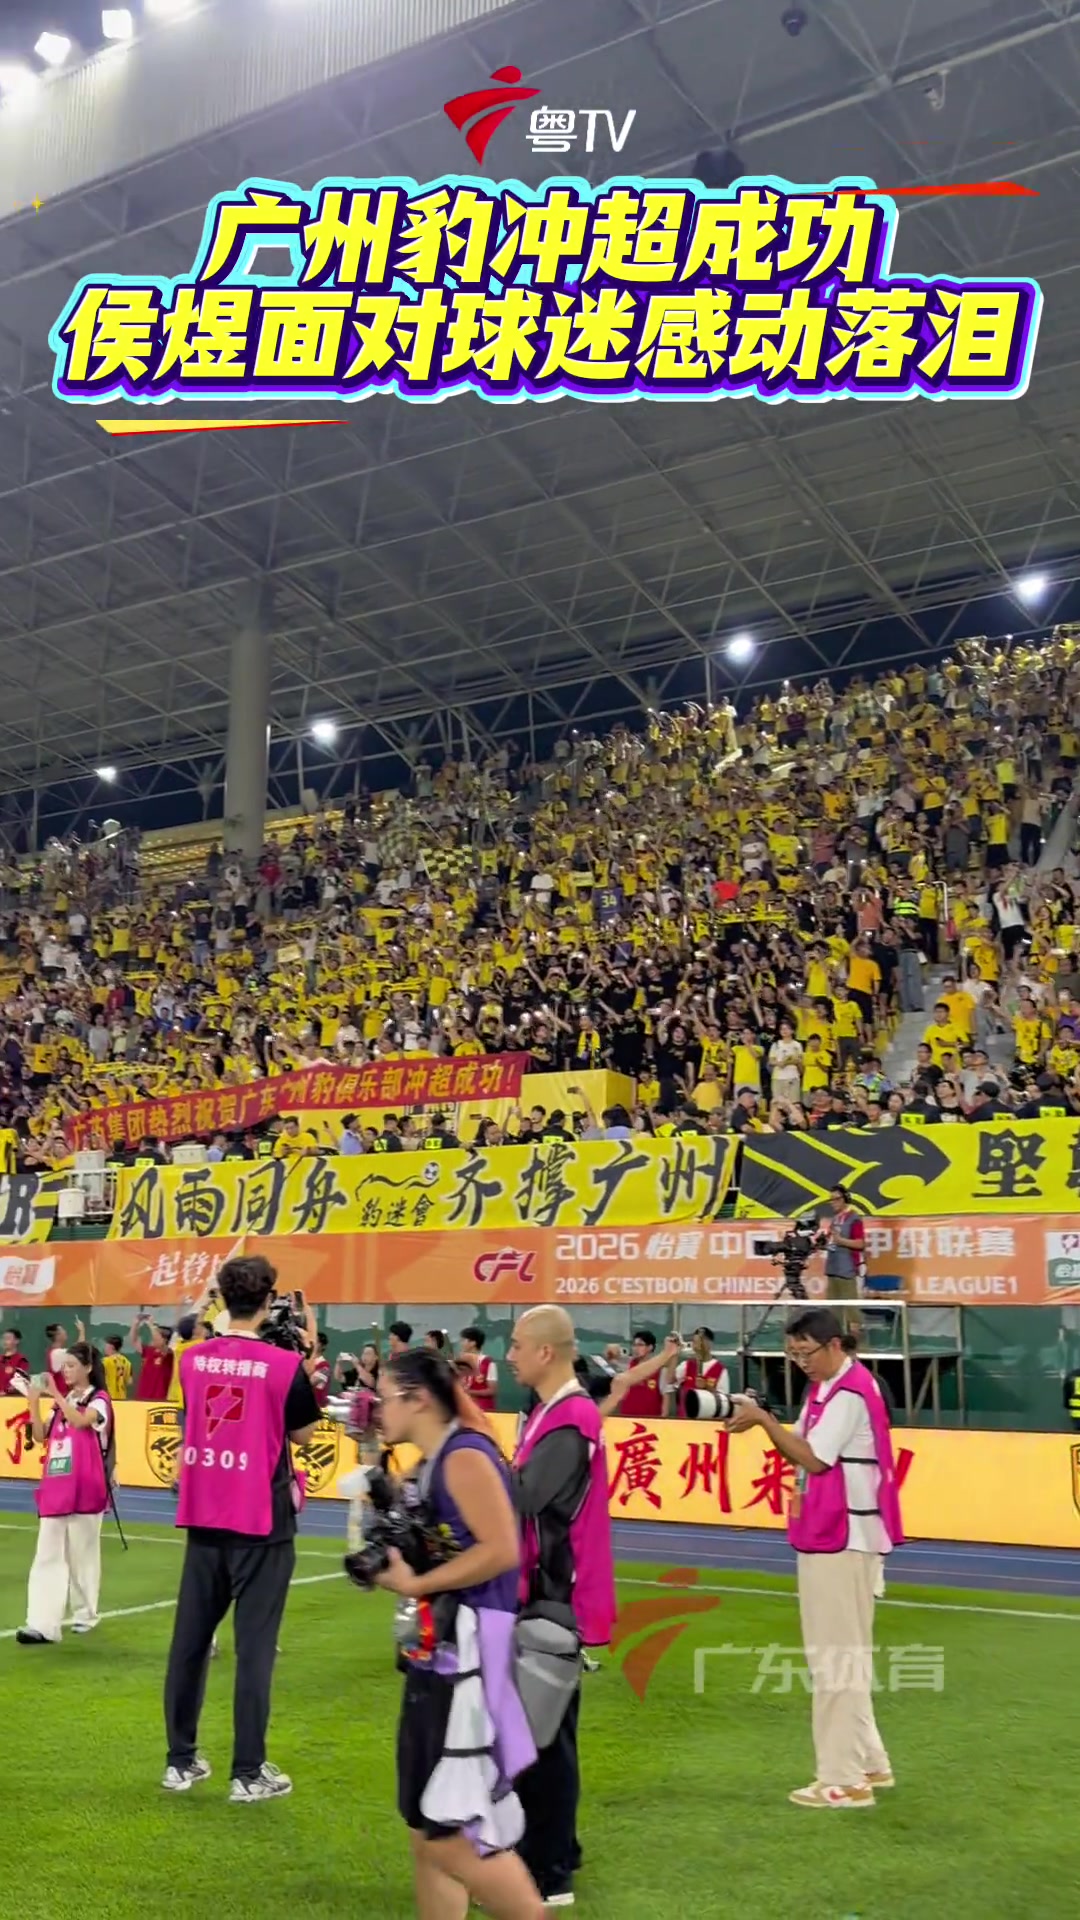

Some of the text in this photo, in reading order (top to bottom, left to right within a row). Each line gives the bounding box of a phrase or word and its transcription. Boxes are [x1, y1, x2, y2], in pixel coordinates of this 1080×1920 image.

[972, 1127, 1080, 1198] 堅
[120, 1155, 348, 1240] 风雨同舟
[555, 1233, 640, 1260] 2026
[555, 1277, 600, 1294] 2026
[603, 1275, 698, 1294] C'ESTBON
[703, 1275, 788, 1294] CHINES
[914, 1276, 1019, 1295] LEAGUE1
[184, 1446, 249, 1472] 0309
